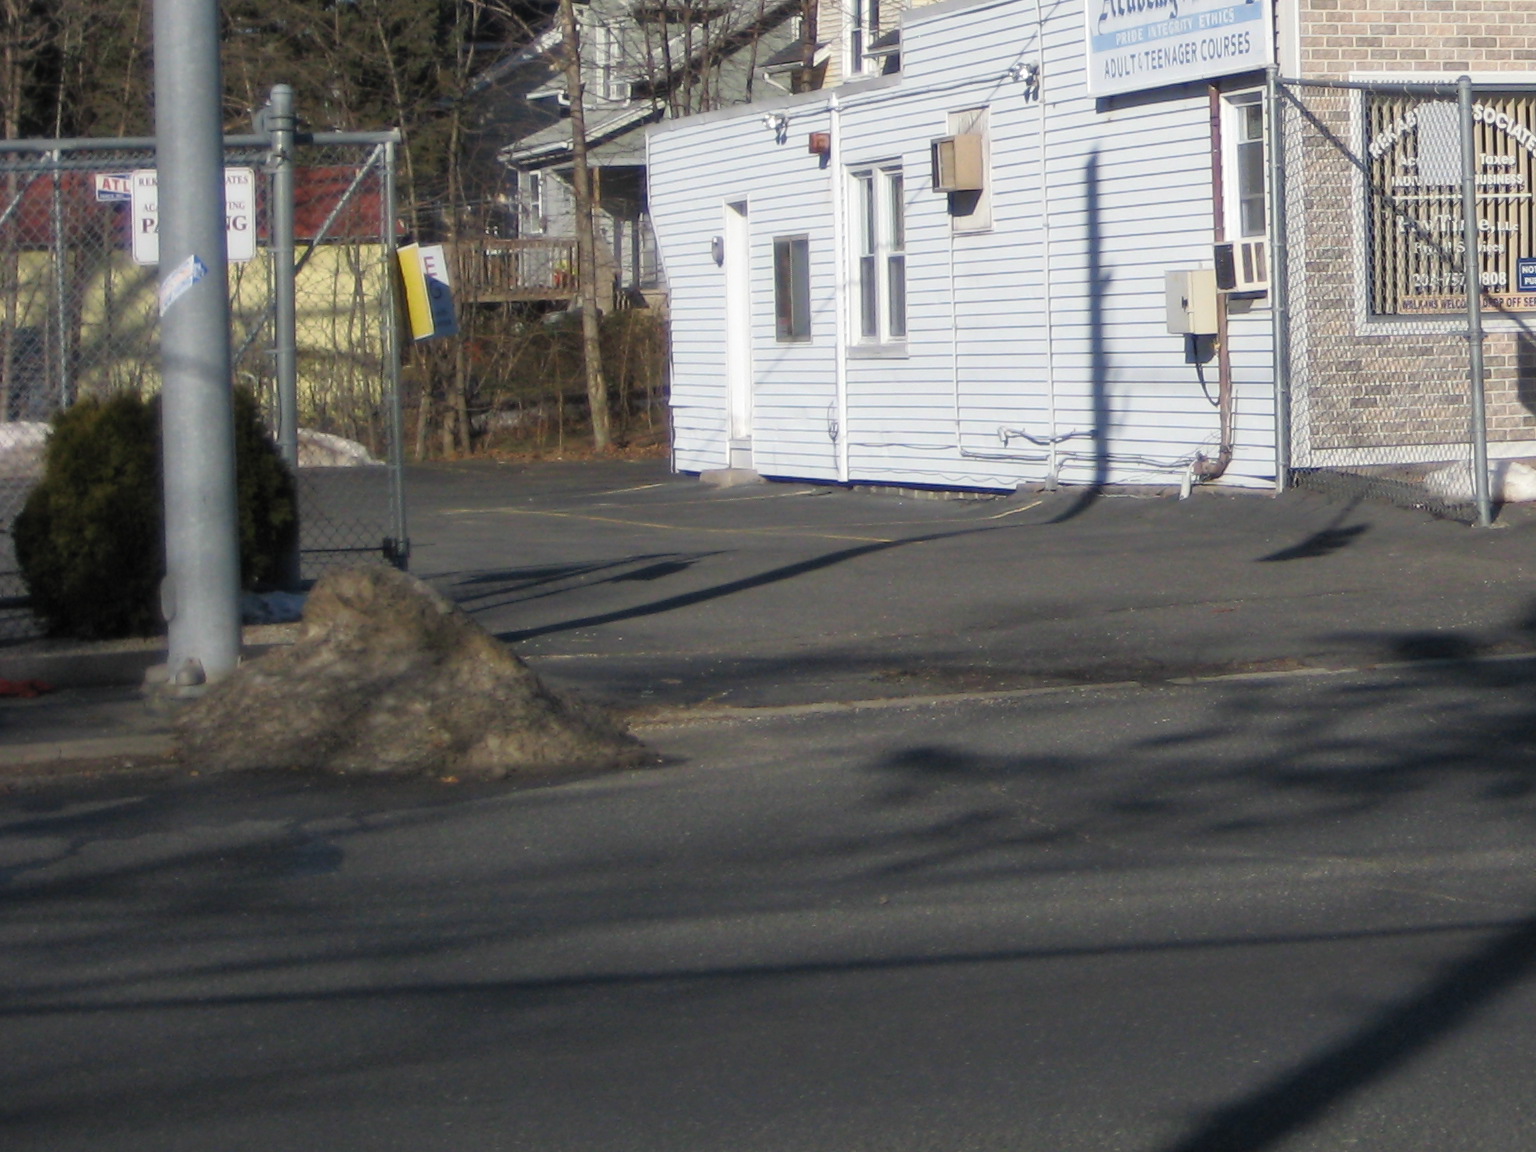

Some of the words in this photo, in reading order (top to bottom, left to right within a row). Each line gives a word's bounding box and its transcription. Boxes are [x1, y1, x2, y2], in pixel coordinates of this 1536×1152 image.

[1115, 28, 1144, 45] PRIDE
[1148, 17, 1193, 40] INTEGRITY
[1199, 8, 1235, 28] ETHICS
[1104, 53, 1137, 79] ADULT
[1144, 42, 1198, 70] TEENAGER
[1200, 31, 1251, 61] COURSES
[1480, 152, 1517, 165] Taxes
[1506, 296, 1522, 308] OFF
